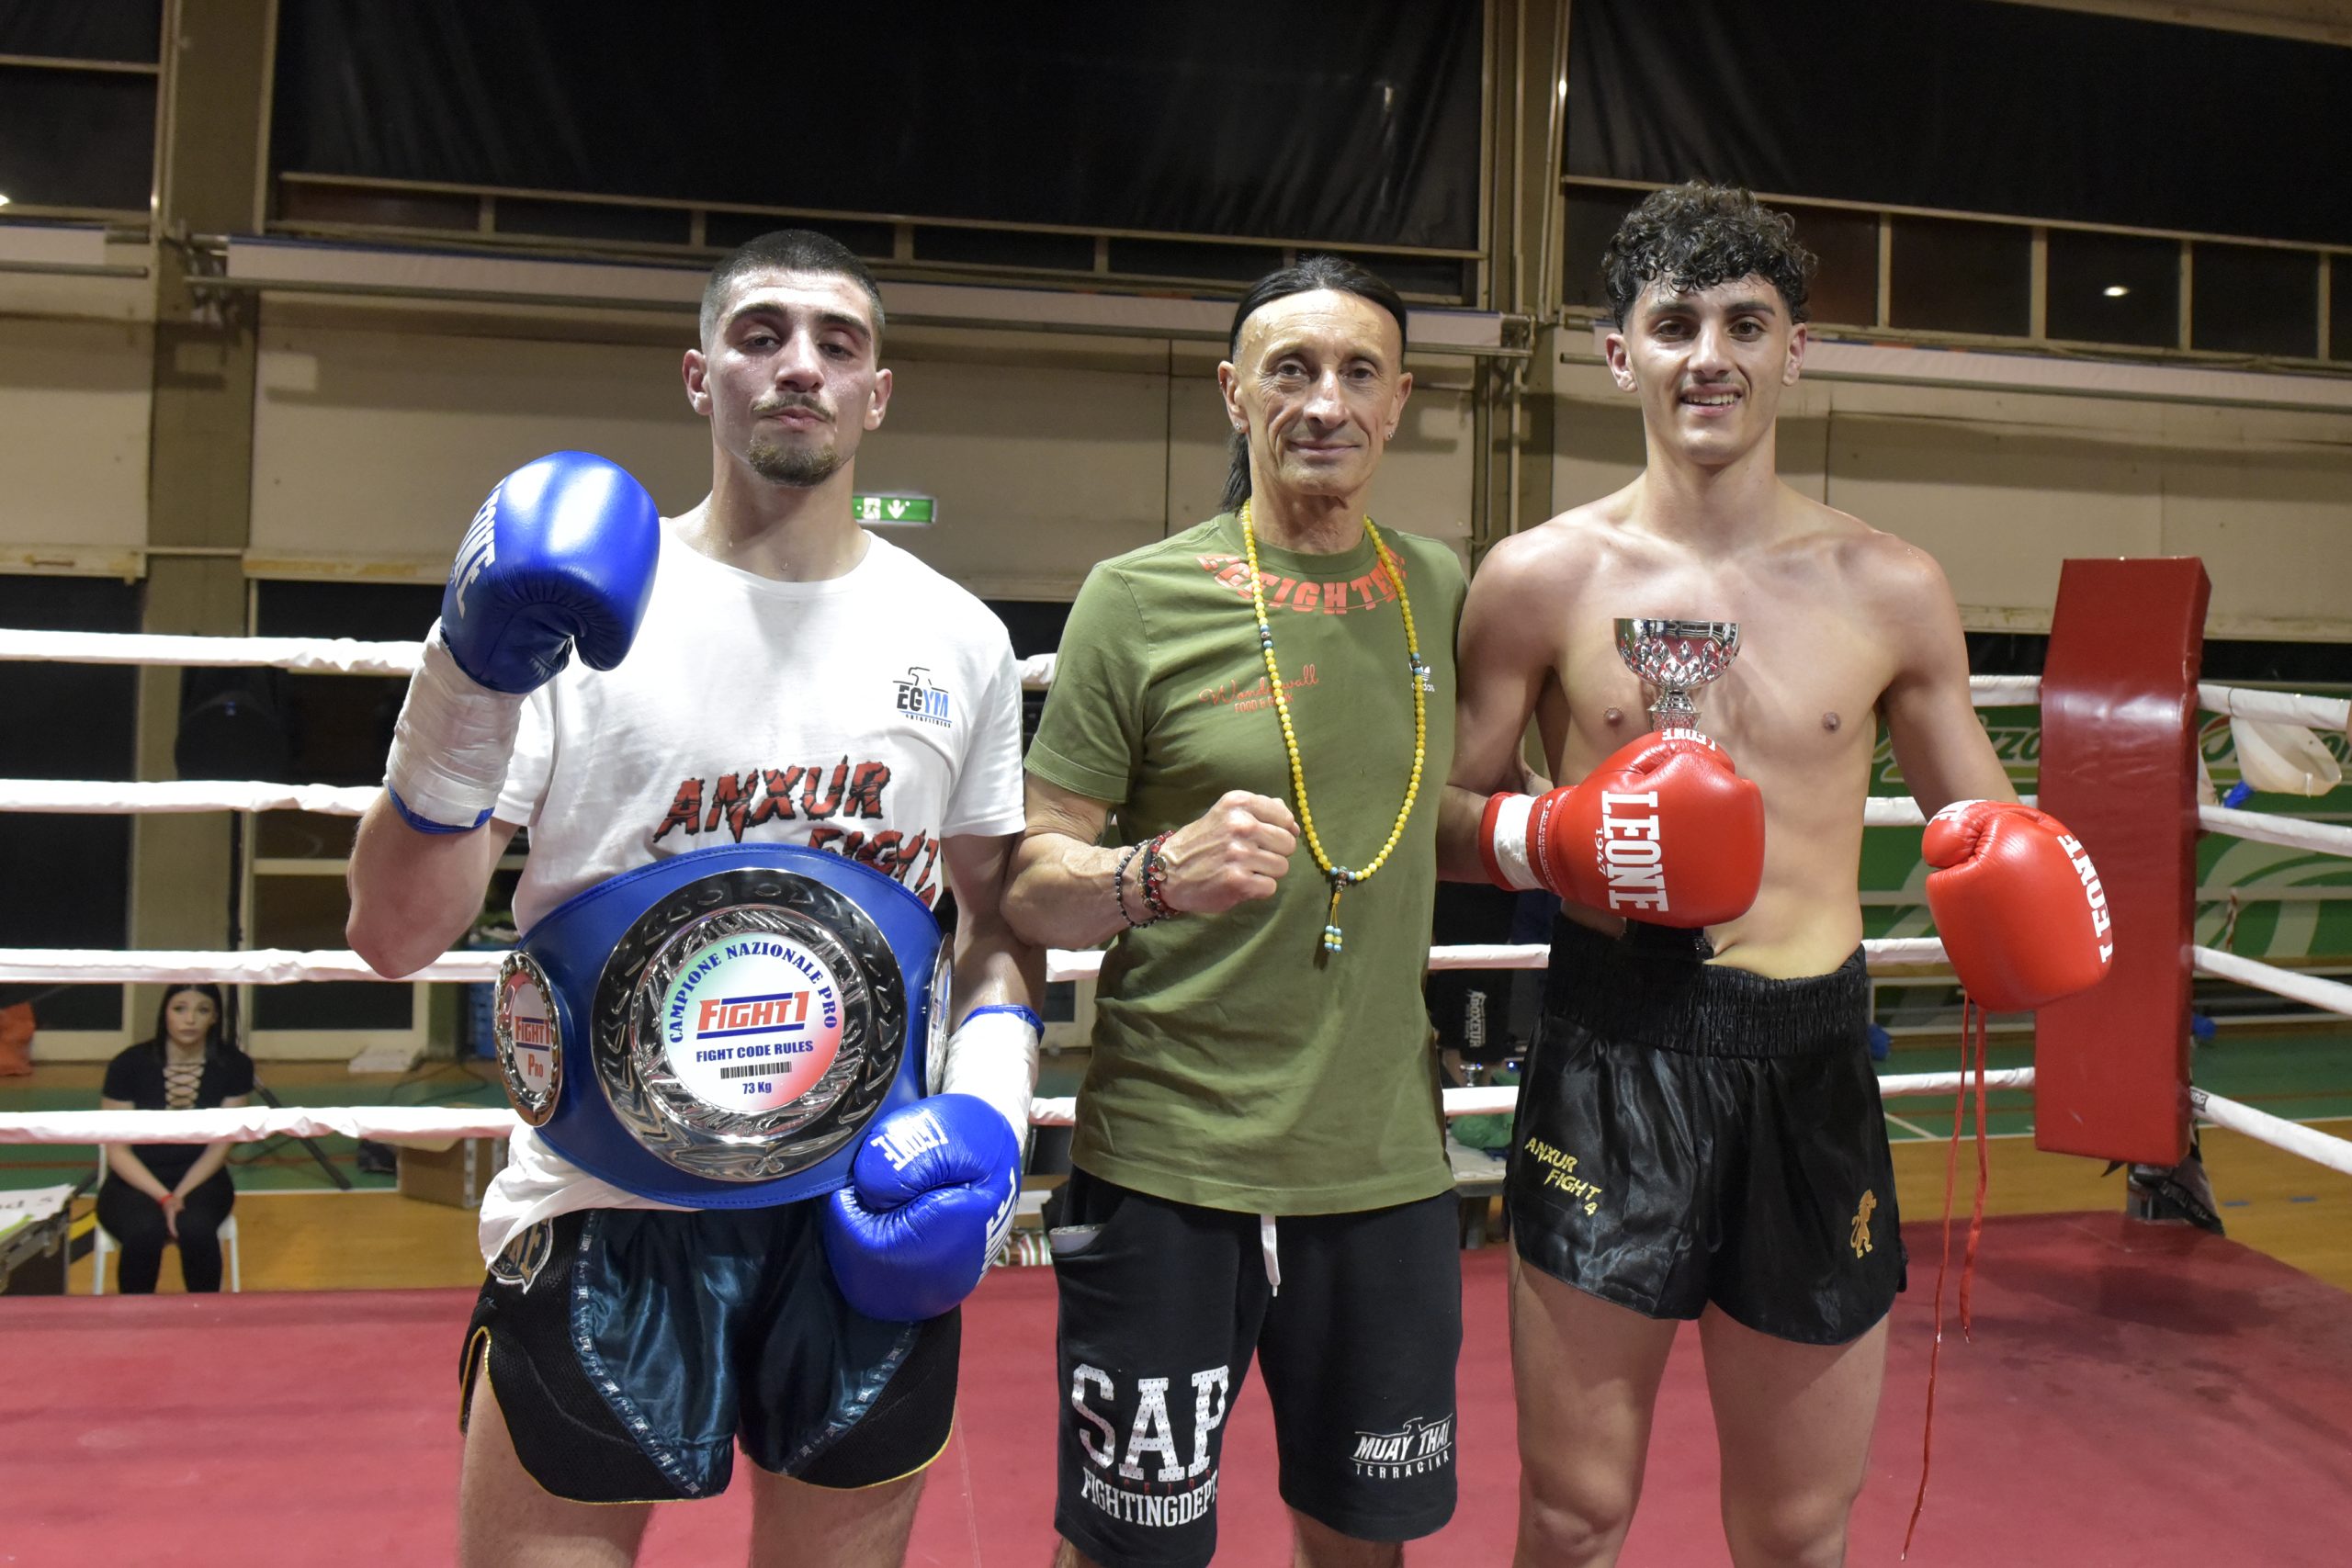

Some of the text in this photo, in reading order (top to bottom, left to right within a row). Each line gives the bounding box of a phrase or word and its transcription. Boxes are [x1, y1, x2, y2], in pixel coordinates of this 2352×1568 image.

[897, 684, 949, 718] EGYM
[1234, 699, 1258, 714] FOOD
[653, 754, 890, 843] ANXUR
[1594, 827, 1608, 877] 1947
[1601, 790, 1669, 912] LEONE
[669, 942, 838, 1043] CAMPIONE NAZIONALE PRO
[697, 991, 809, 1032] FIGHT1
[695, 1040, 814, 1063] FIGHT CODE RULES
[742, 1081, 772, 1094] 73 Kg
[870, 1108, 949, 1172] LEONE
[1524, 1137, 1578, 1174] ANXUR
[1544, 1168, 1602, 1201] FIGHT
[1072, 1363, 1229, 1482] SAP
[1353, 1420, 1451, 1461] MUAY THAI
[1355, 1450, 1450, 1479] TERRACINA
